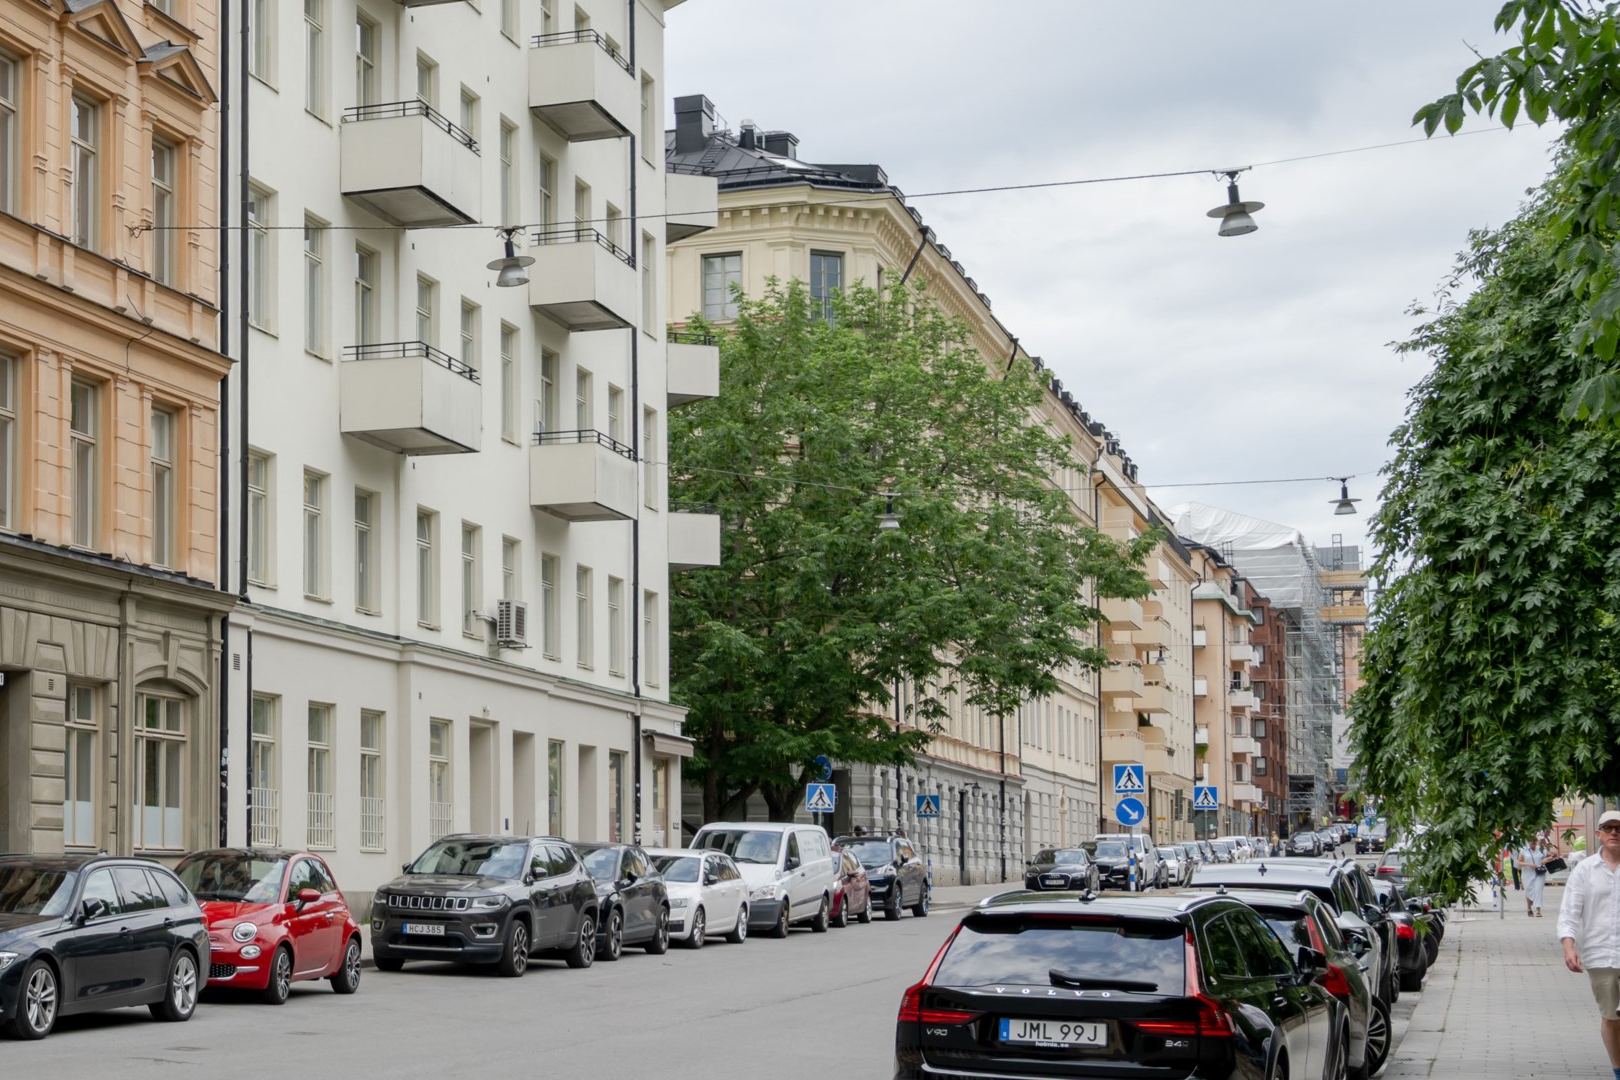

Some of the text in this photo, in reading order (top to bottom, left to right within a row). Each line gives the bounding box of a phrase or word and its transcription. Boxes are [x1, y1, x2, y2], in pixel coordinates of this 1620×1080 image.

[426, 925, 442, 934] 385
[995, 987, 1111, 997] VOLVO
[926, 1028, 948, 1036] V90
[1017, 1021, 1098, 1042] JML 99J
